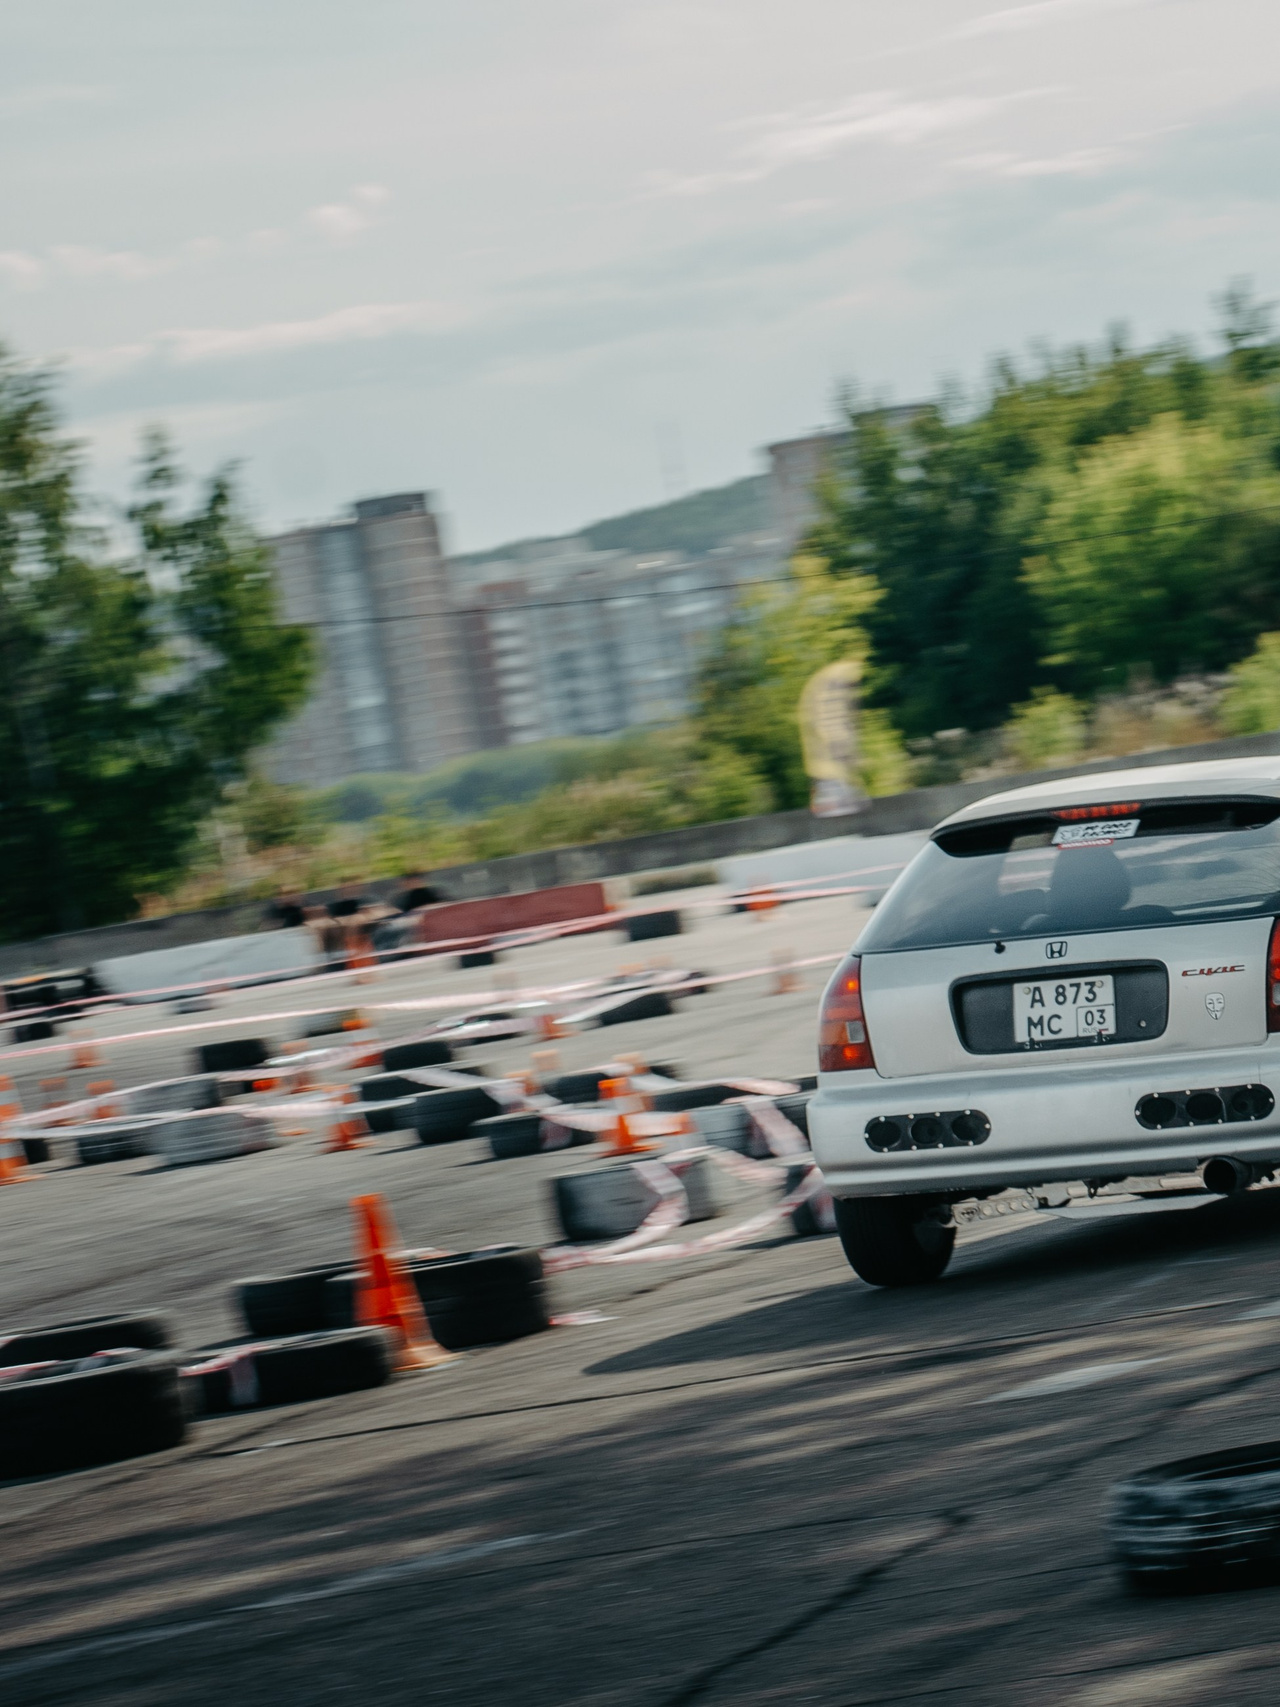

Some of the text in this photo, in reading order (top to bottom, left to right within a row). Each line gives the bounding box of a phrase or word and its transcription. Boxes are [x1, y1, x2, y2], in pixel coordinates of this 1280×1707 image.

[1030, 981, 1098, 1009] A 873
[1027, 1008, 1107, 1038] MC 03
[1082, 1026, 1099, 1034] RUS
